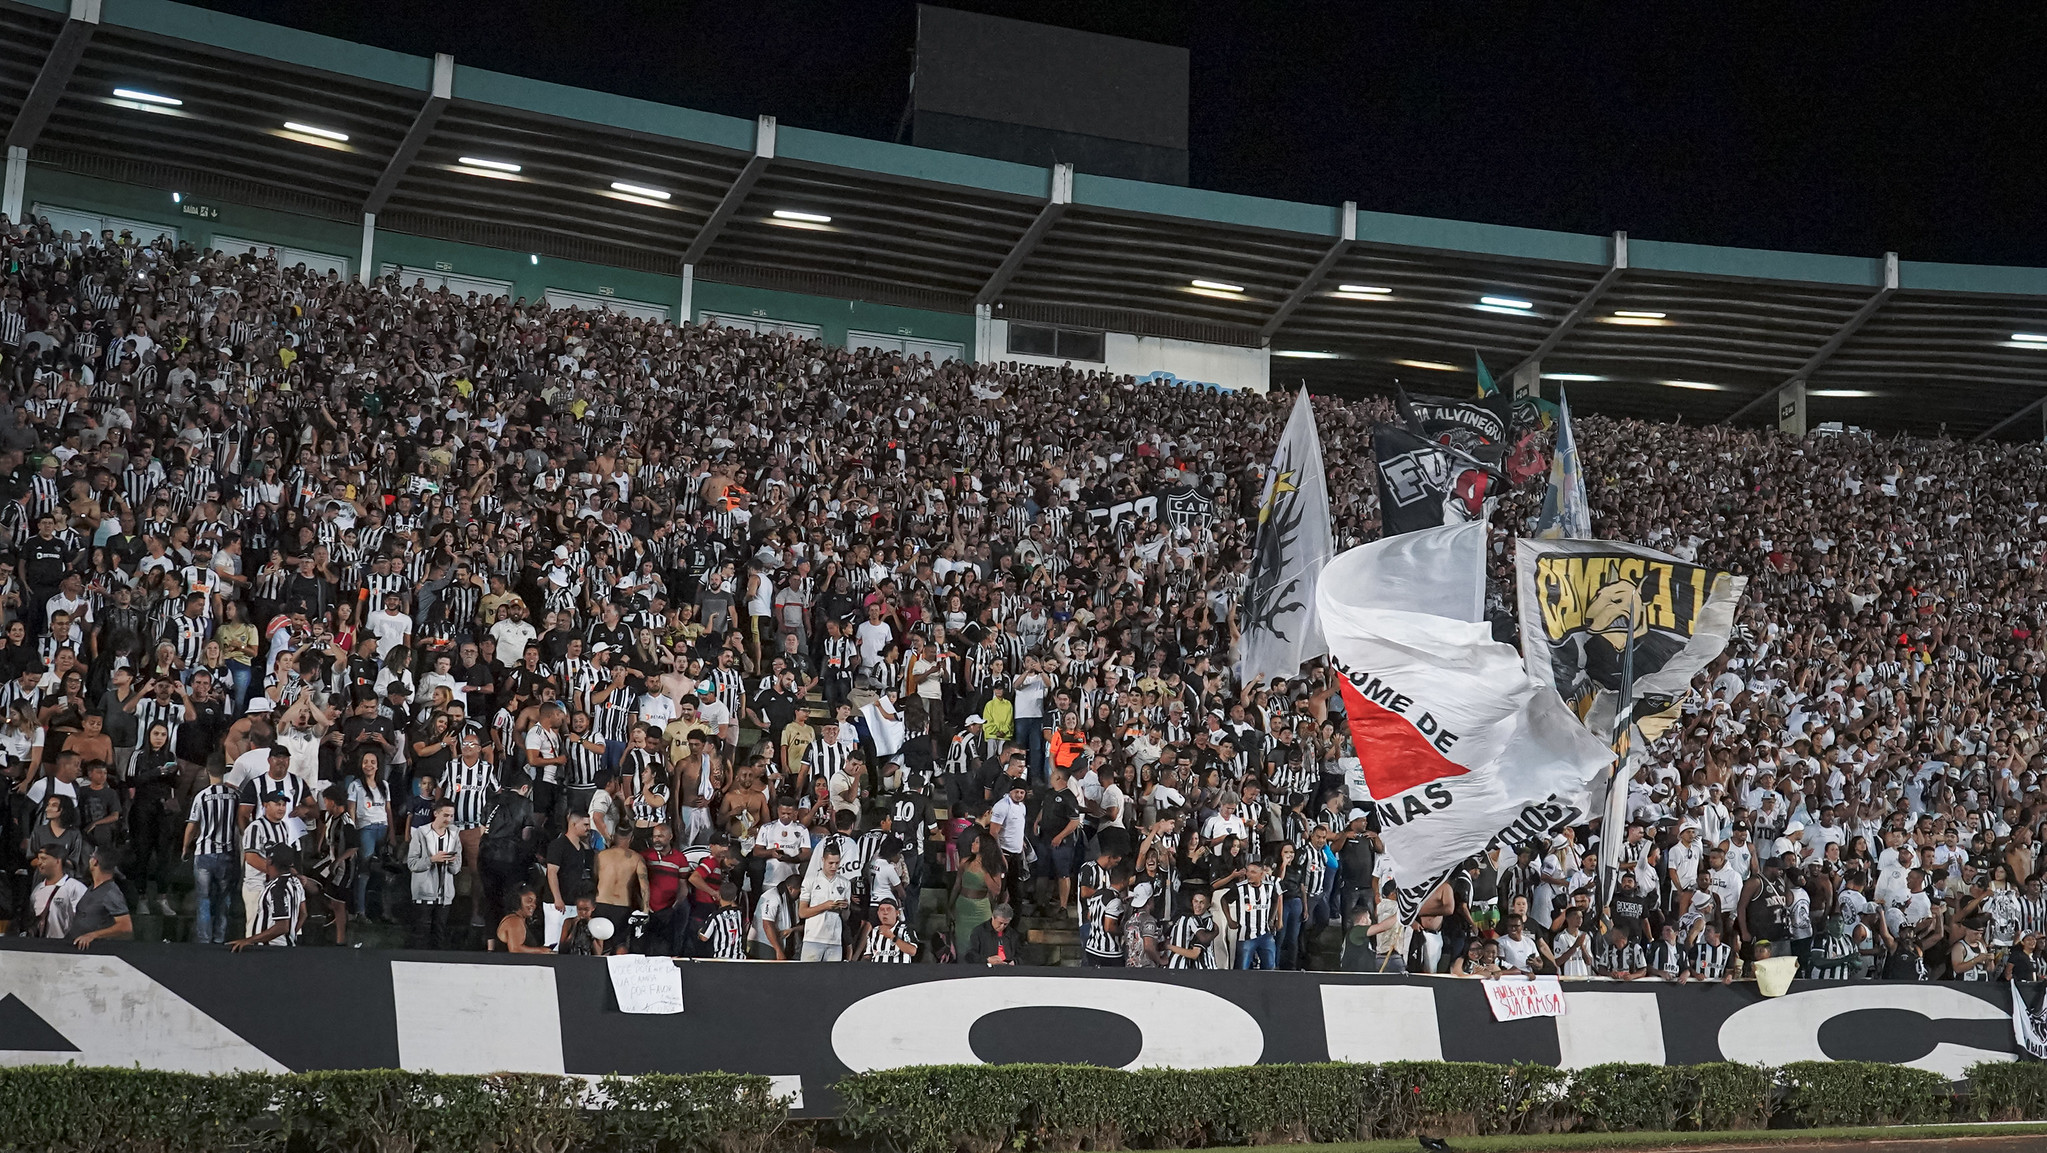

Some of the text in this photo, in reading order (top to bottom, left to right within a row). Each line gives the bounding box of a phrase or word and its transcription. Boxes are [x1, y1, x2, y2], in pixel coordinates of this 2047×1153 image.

[1174, 500, 1209, 513] CAM
[1416, 712, 1460, 754] DE
[893, 800, 915, 822] 10
